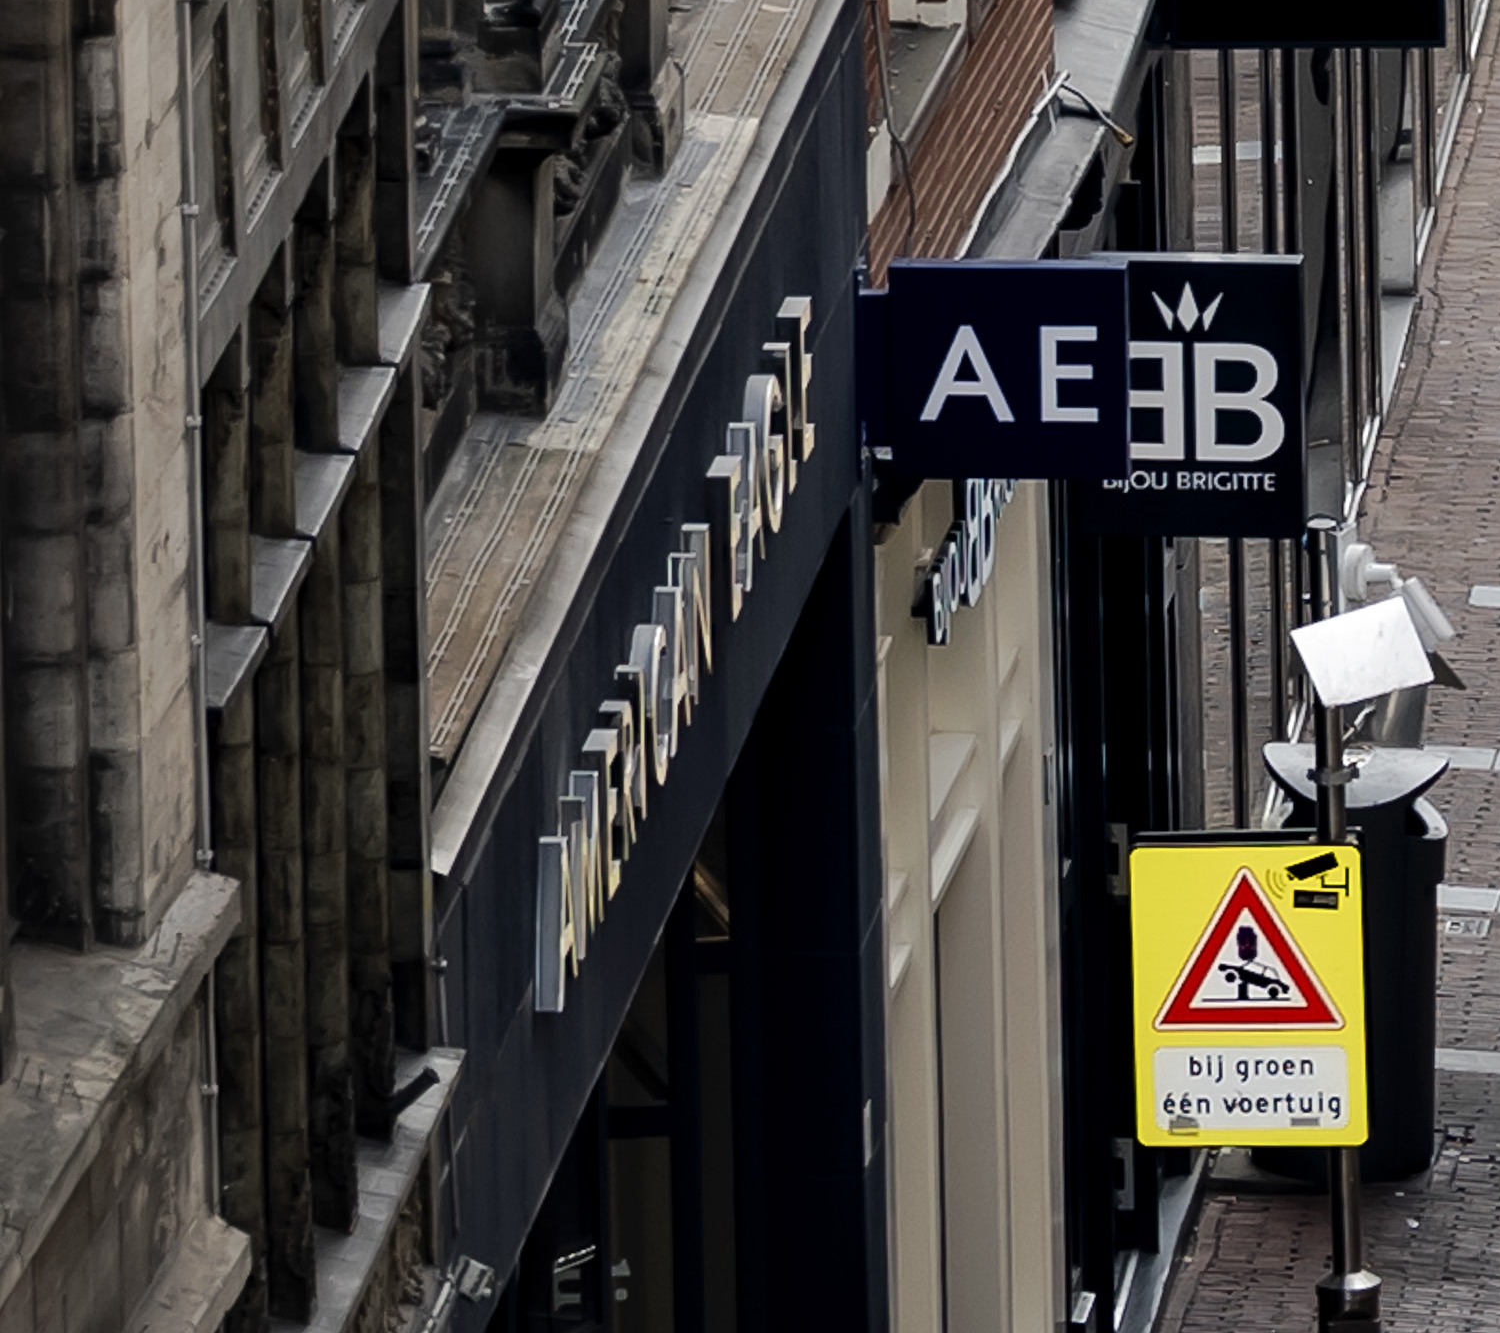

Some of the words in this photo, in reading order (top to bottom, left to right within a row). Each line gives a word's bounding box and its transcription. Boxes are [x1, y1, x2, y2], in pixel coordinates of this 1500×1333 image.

[1177, 471, 1277, 491] BRIGITTE
[1188, 1056, 1224, 1083] bij
[1236, 1059, 1314, 1083] groen
[1163, 1092, 1210, 1114] één
[1223, 1091, 1342, 1120] voertuig
